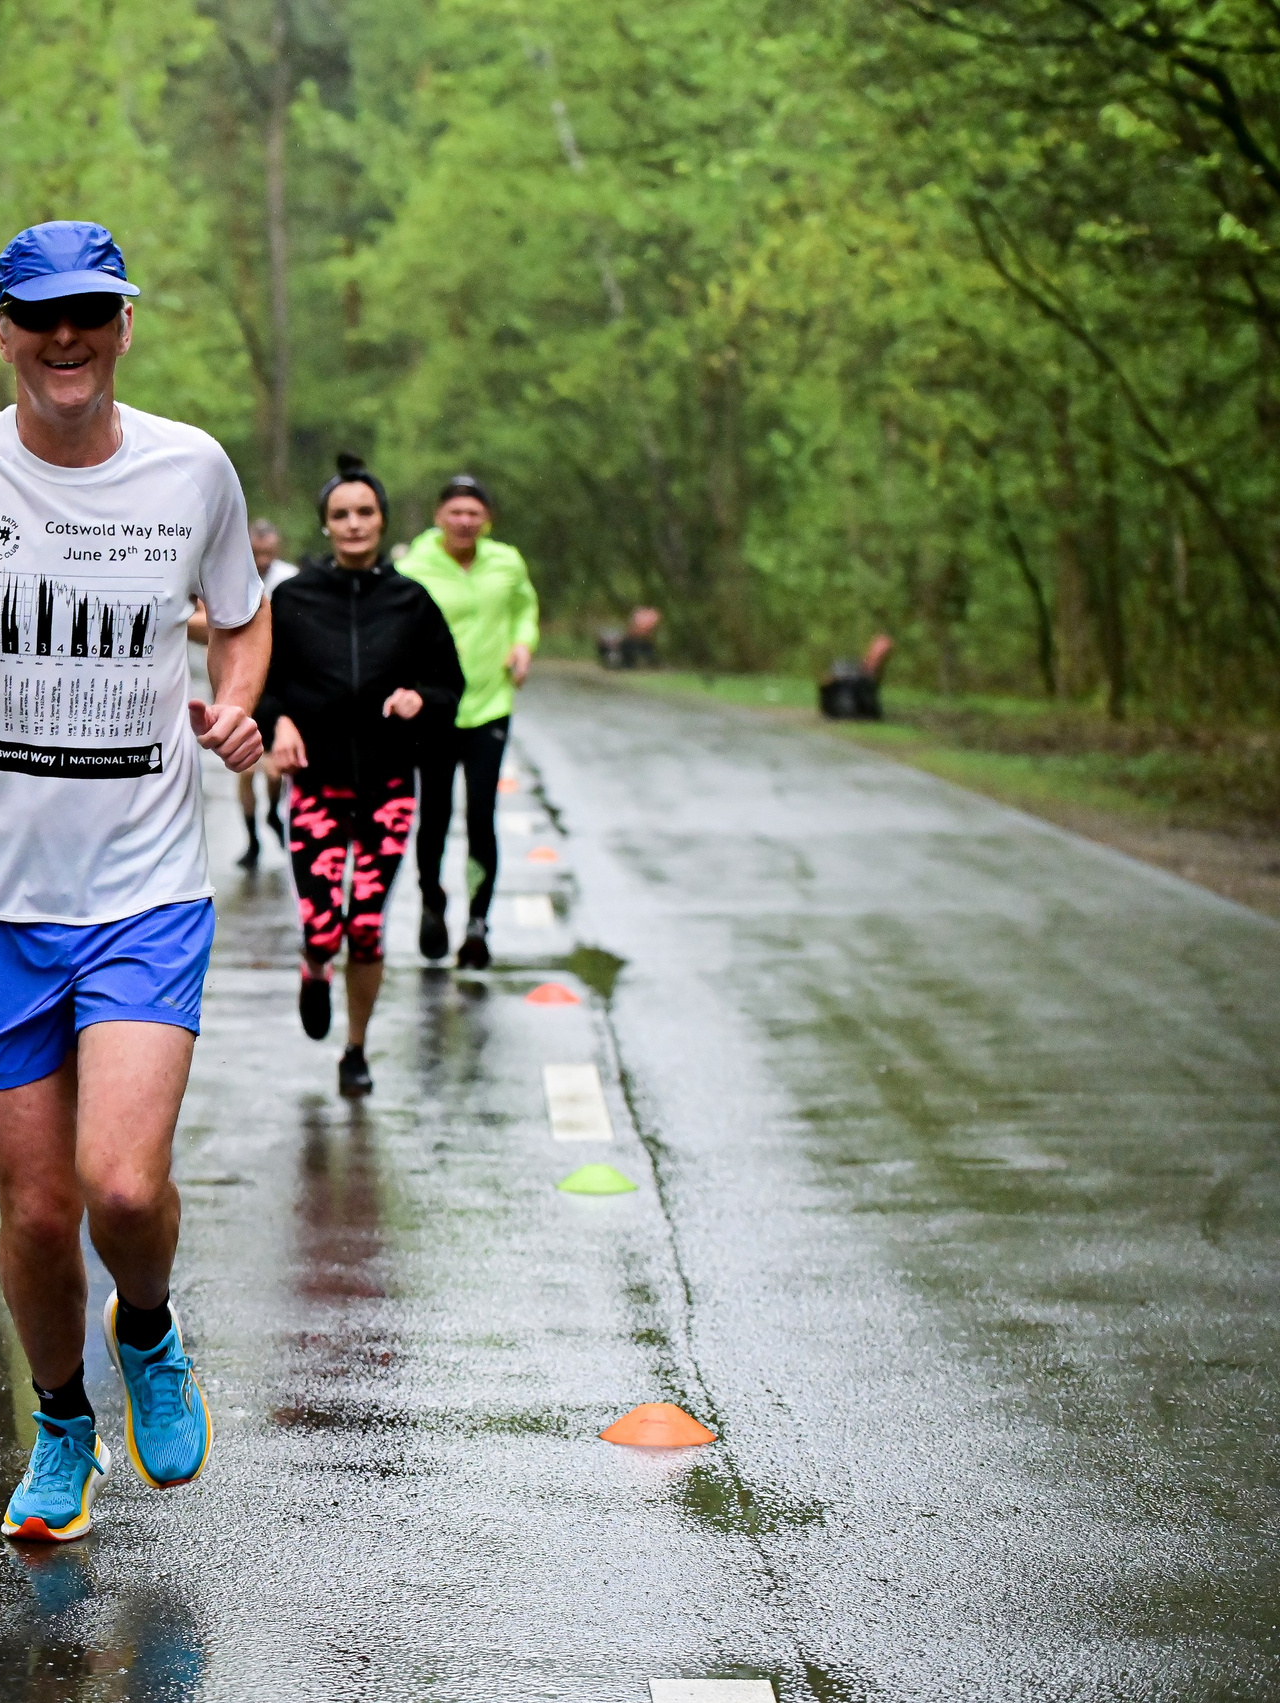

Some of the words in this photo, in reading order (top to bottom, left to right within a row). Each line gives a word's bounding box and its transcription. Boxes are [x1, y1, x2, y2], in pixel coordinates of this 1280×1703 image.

[1, 515, 19, 530] BATH
[45, 521, 116, 536] Cotswold
[121, 525, 153, 539] Way
[158, 524, 192, 539] Relay
[4, 544, 19, 559] CLUB
[63, 548, 102, 561] June
[144, 549, 177, 561] 2013
[9, 641, 12, 651] 1
[24, 642, 30, 652] 2
[41, 643, 47, 653] 3
[57, 644, 64, 653] 4
[77, 644, 83, 655] 5
[91, 645, 97, 655] 6
[103, 645, 110, 654] 7
[118, 645, 124, 655] 8
[134, 645, 139, 655] 9
[144, 645, 152, 655] 10
[30, 751, 56, 766] Way
[69, 756, 125, 765] NATIONAL
